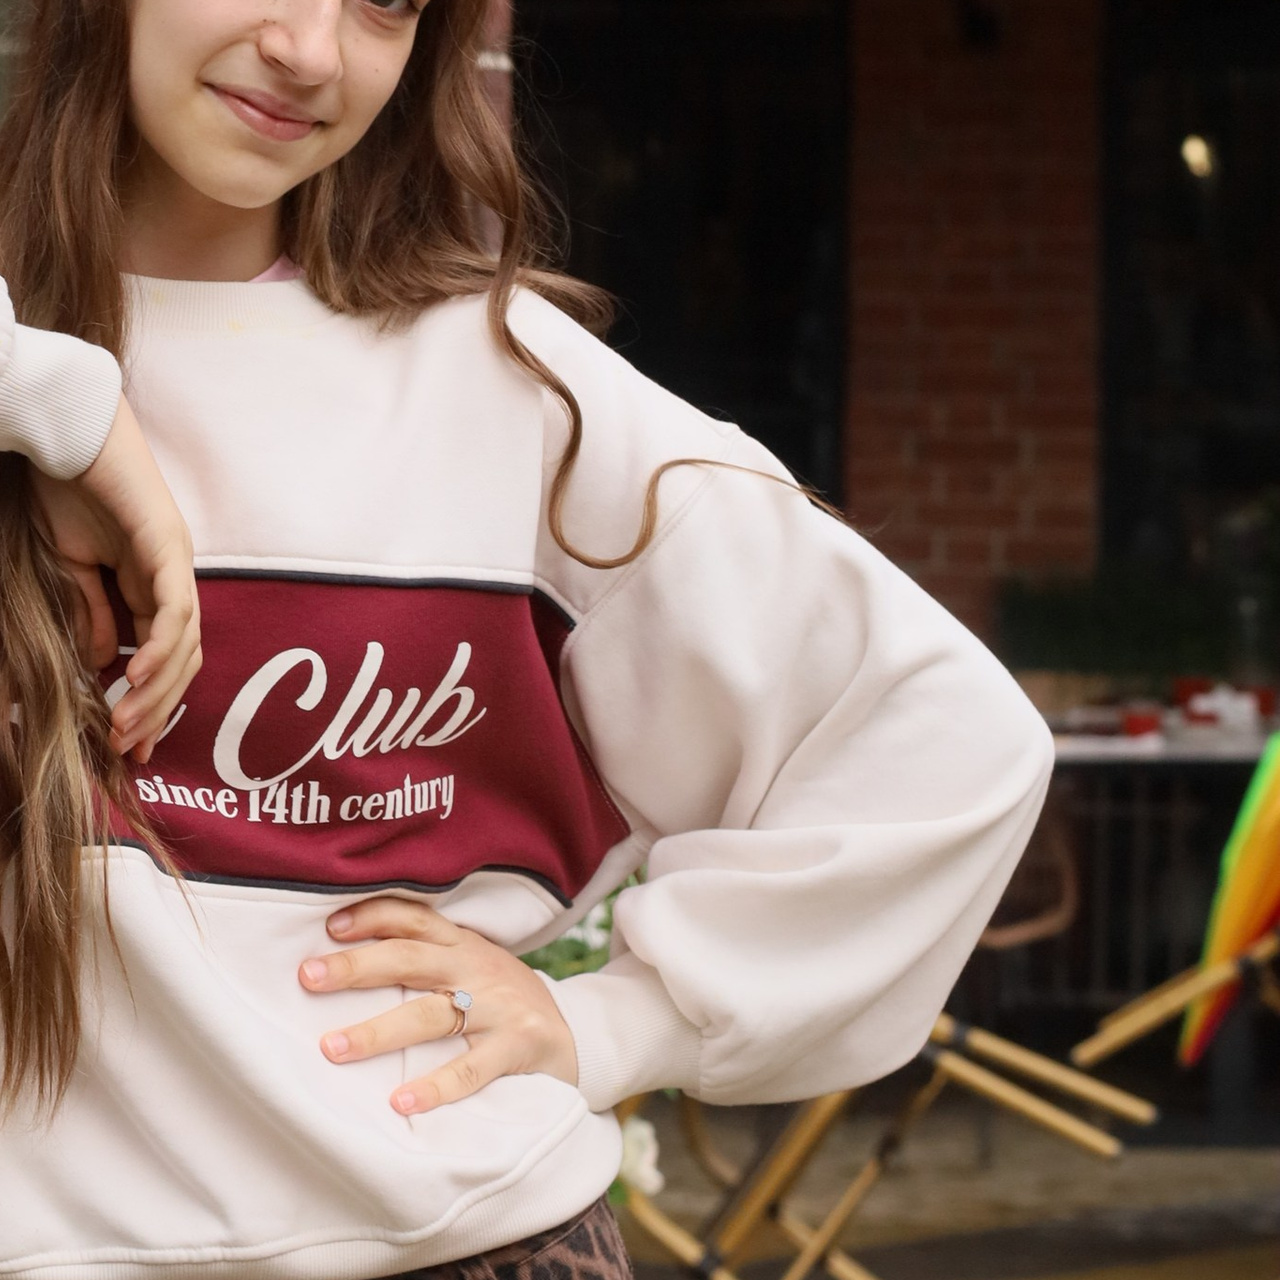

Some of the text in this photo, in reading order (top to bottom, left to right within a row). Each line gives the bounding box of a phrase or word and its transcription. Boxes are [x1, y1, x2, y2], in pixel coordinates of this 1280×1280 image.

[213, 641, 487, 791] Club
[138, 774, 455, 824] since 14th century
